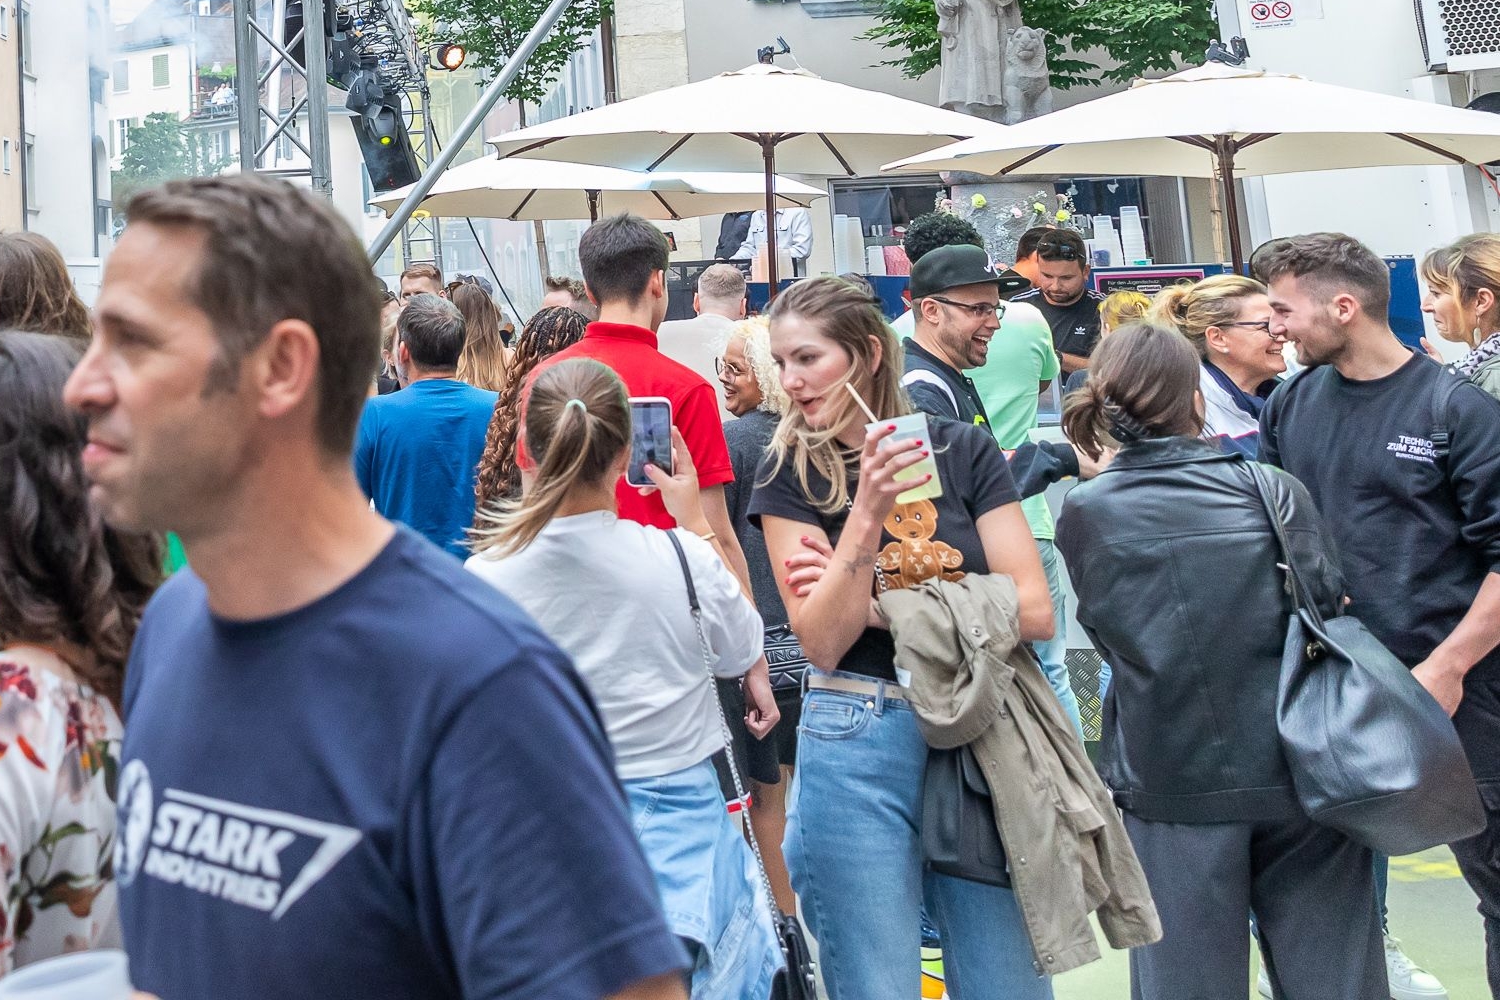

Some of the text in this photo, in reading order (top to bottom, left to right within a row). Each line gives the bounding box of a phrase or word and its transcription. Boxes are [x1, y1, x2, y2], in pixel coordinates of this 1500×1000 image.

[1386, 442, 1407, 452] ZUM
[1398, 435, 1433, 448] TECHNO
[151, 801, 296, 878] STARK
[144, 846, 282, 911] INDUSTRIES
